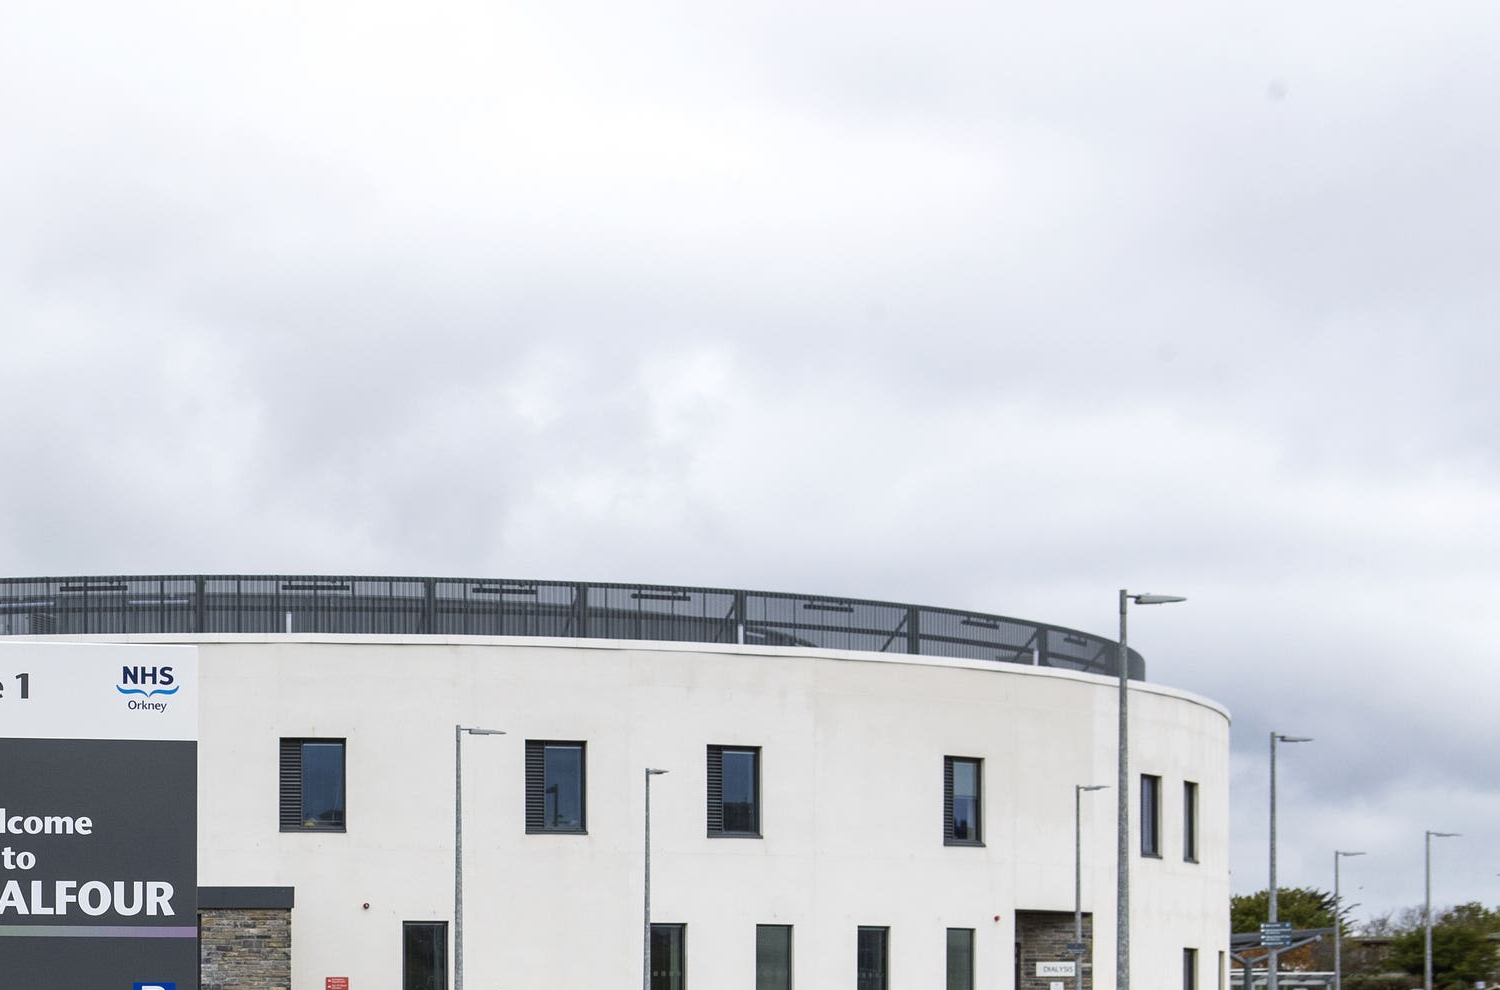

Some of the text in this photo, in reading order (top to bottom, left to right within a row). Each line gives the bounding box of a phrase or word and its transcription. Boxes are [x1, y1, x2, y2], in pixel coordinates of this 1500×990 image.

[123, 666, 173, 684] NHS
[16, 673, 28, 699] 1
[128, 701, 167, 713] Orkney
[2, 847, 35, 869] to
[1043, 965, 1073, 973] DIALYSIS
